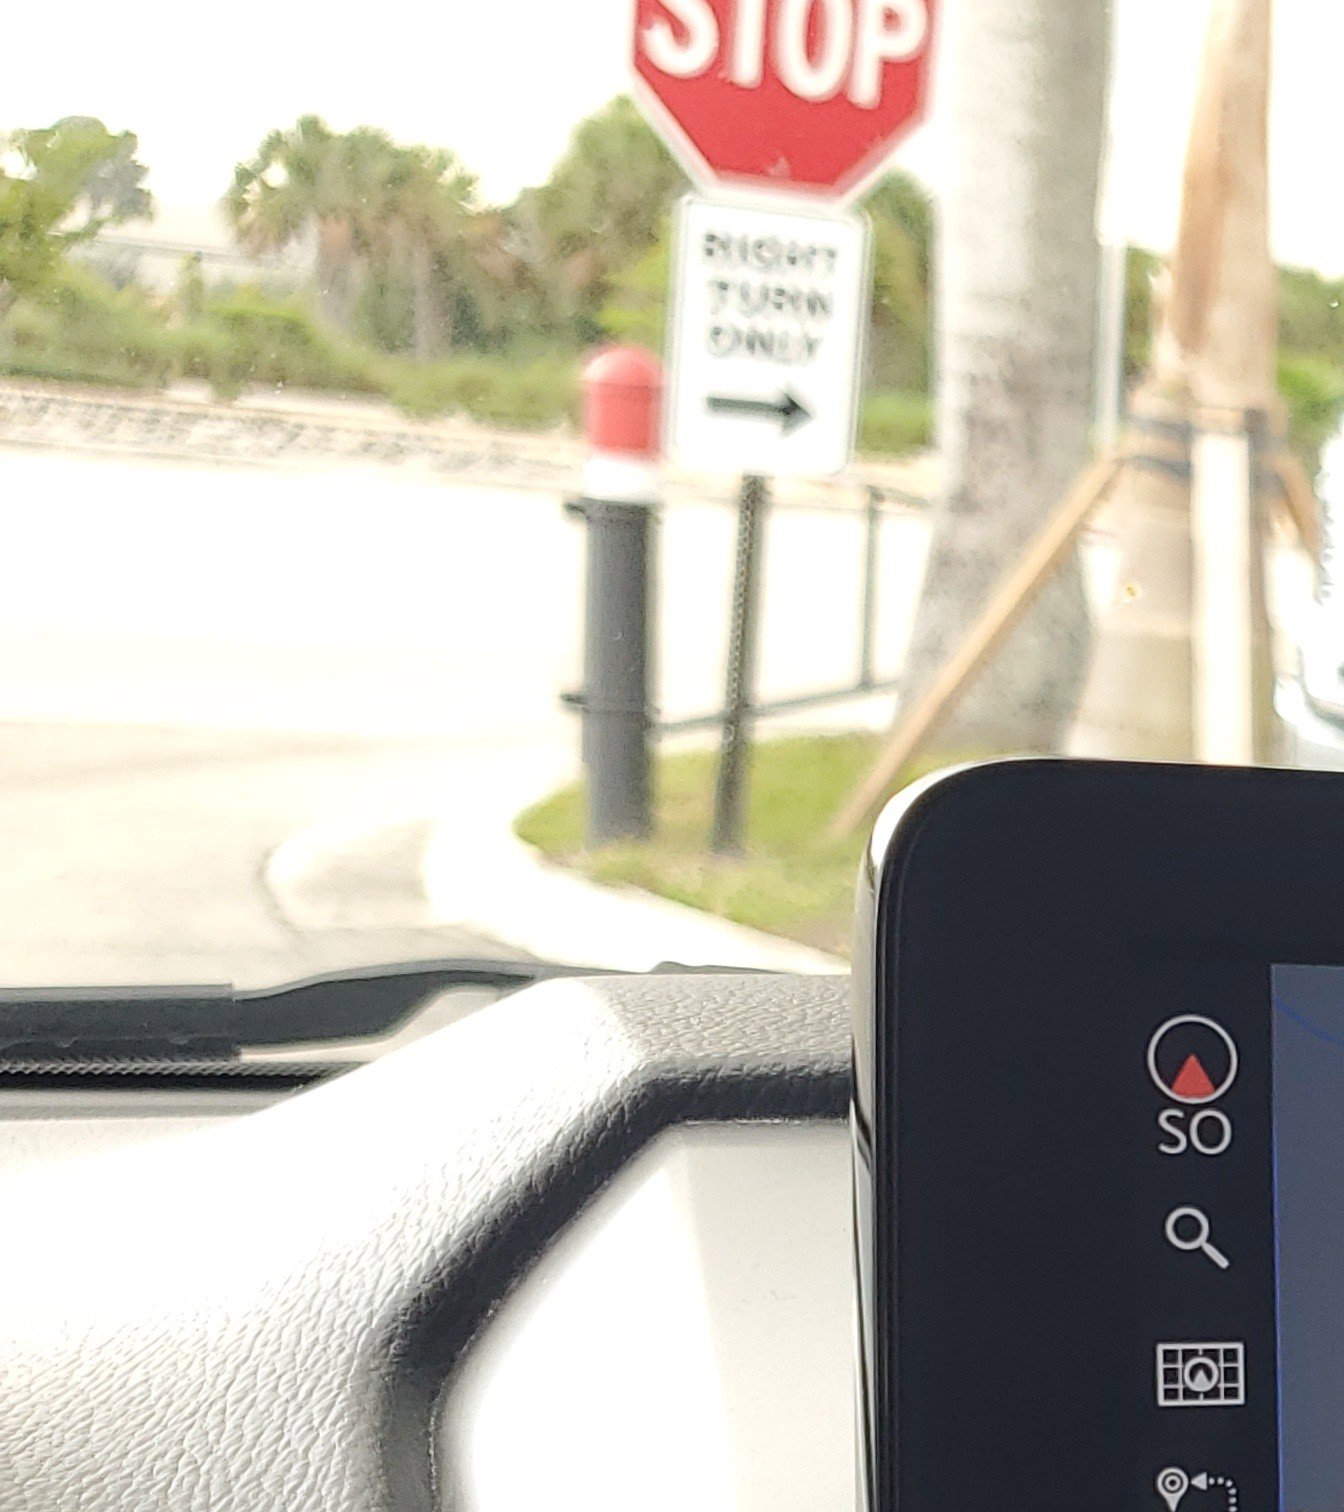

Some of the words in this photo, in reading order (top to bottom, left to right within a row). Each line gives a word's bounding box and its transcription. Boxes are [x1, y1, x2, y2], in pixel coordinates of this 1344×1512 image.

[642, 0, 930, 109] STOP
[704, 231, 838, 278] RIGHT
[707, 279, 834, 323] TURN
[708, 323, 823, 367] ONLY
[1157, 1108, 1232, 1156] SO
